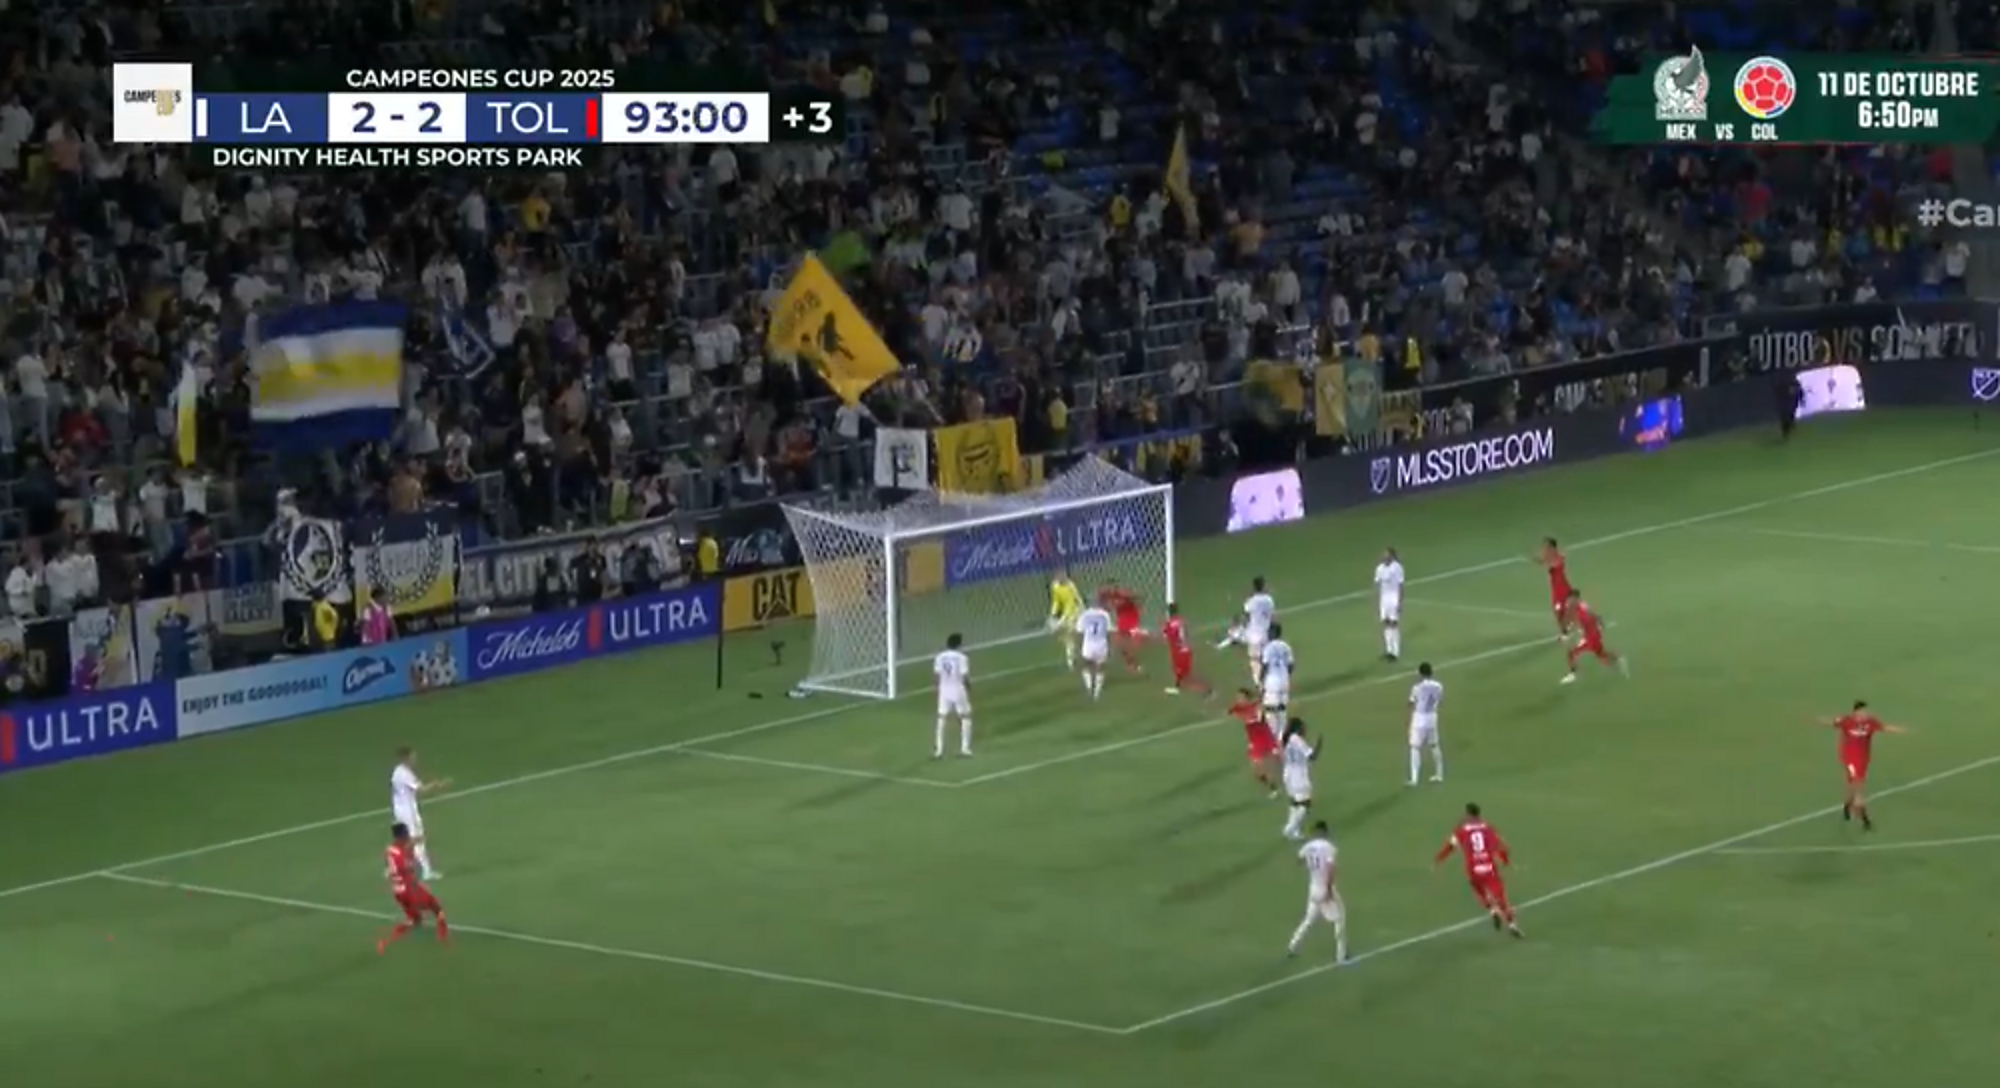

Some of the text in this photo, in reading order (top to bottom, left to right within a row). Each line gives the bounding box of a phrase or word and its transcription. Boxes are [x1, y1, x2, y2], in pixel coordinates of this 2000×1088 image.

[1397, 427, 1554, 488] MLSSTORE.COM
[753, 571, 800, 621] CAT
[477, 596, 709, 669] Michelob ULTRA
[26, 697, 160, 751] ULTRA
[182, 697, 218, 714] ENJOY
[222, 688, 244, 707] THE
[1470, 831, 1485, 852] 9
